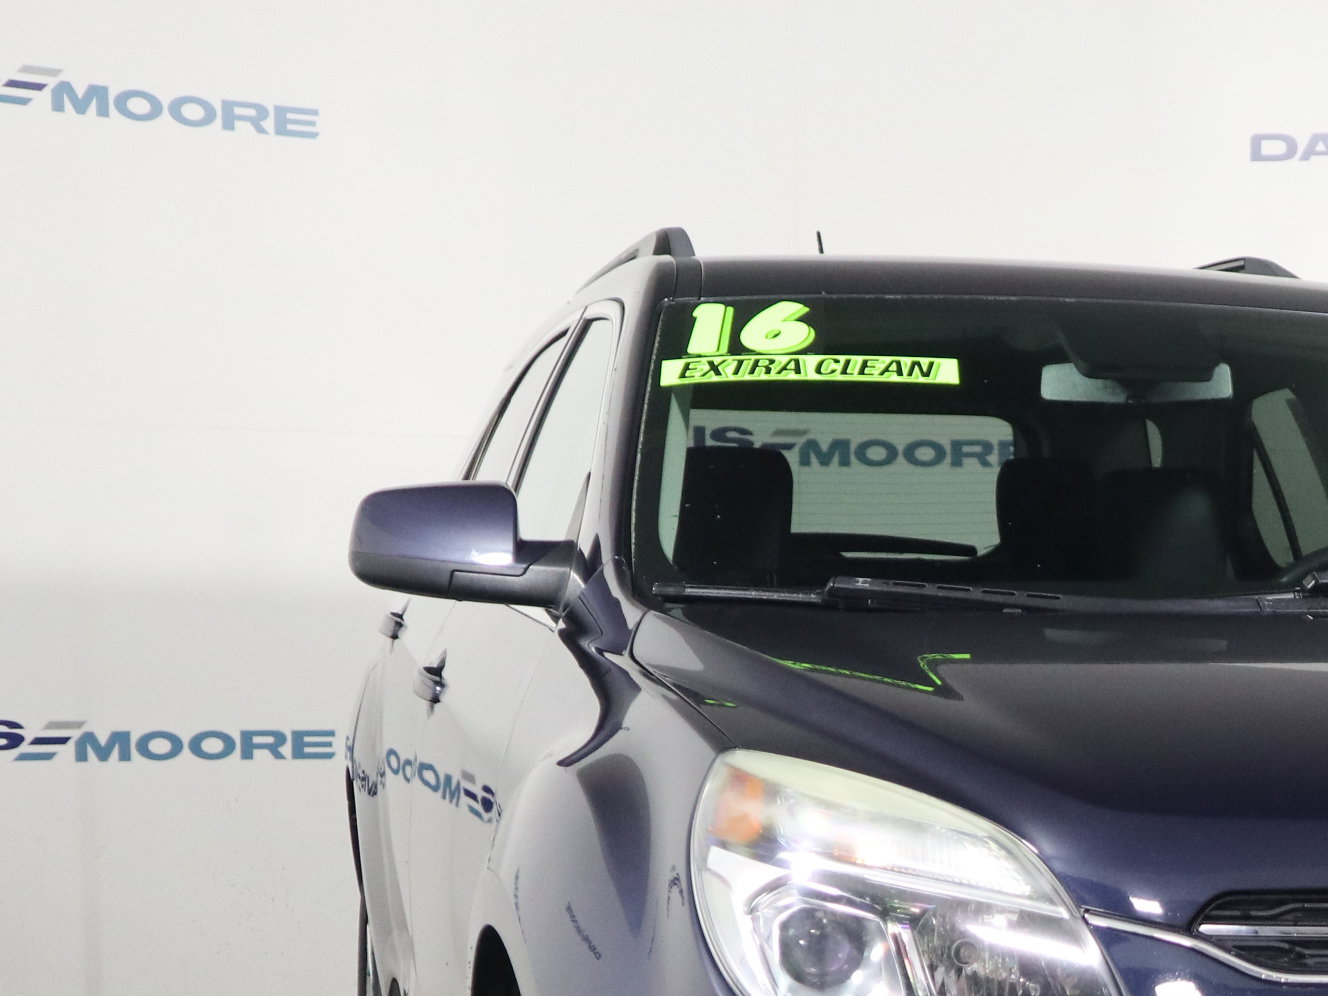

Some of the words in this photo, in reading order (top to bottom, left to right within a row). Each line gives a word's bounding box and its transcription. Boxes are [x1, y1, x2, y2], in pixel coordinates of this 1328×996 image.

[51, 80, 319, 139] MOORE
[686, 300, 816, 355] 16
[678, 358, 805, 381] EXTRA
[814, 357, 940, 381] CLEAN
[75, 730, 336, 762] MOORE
